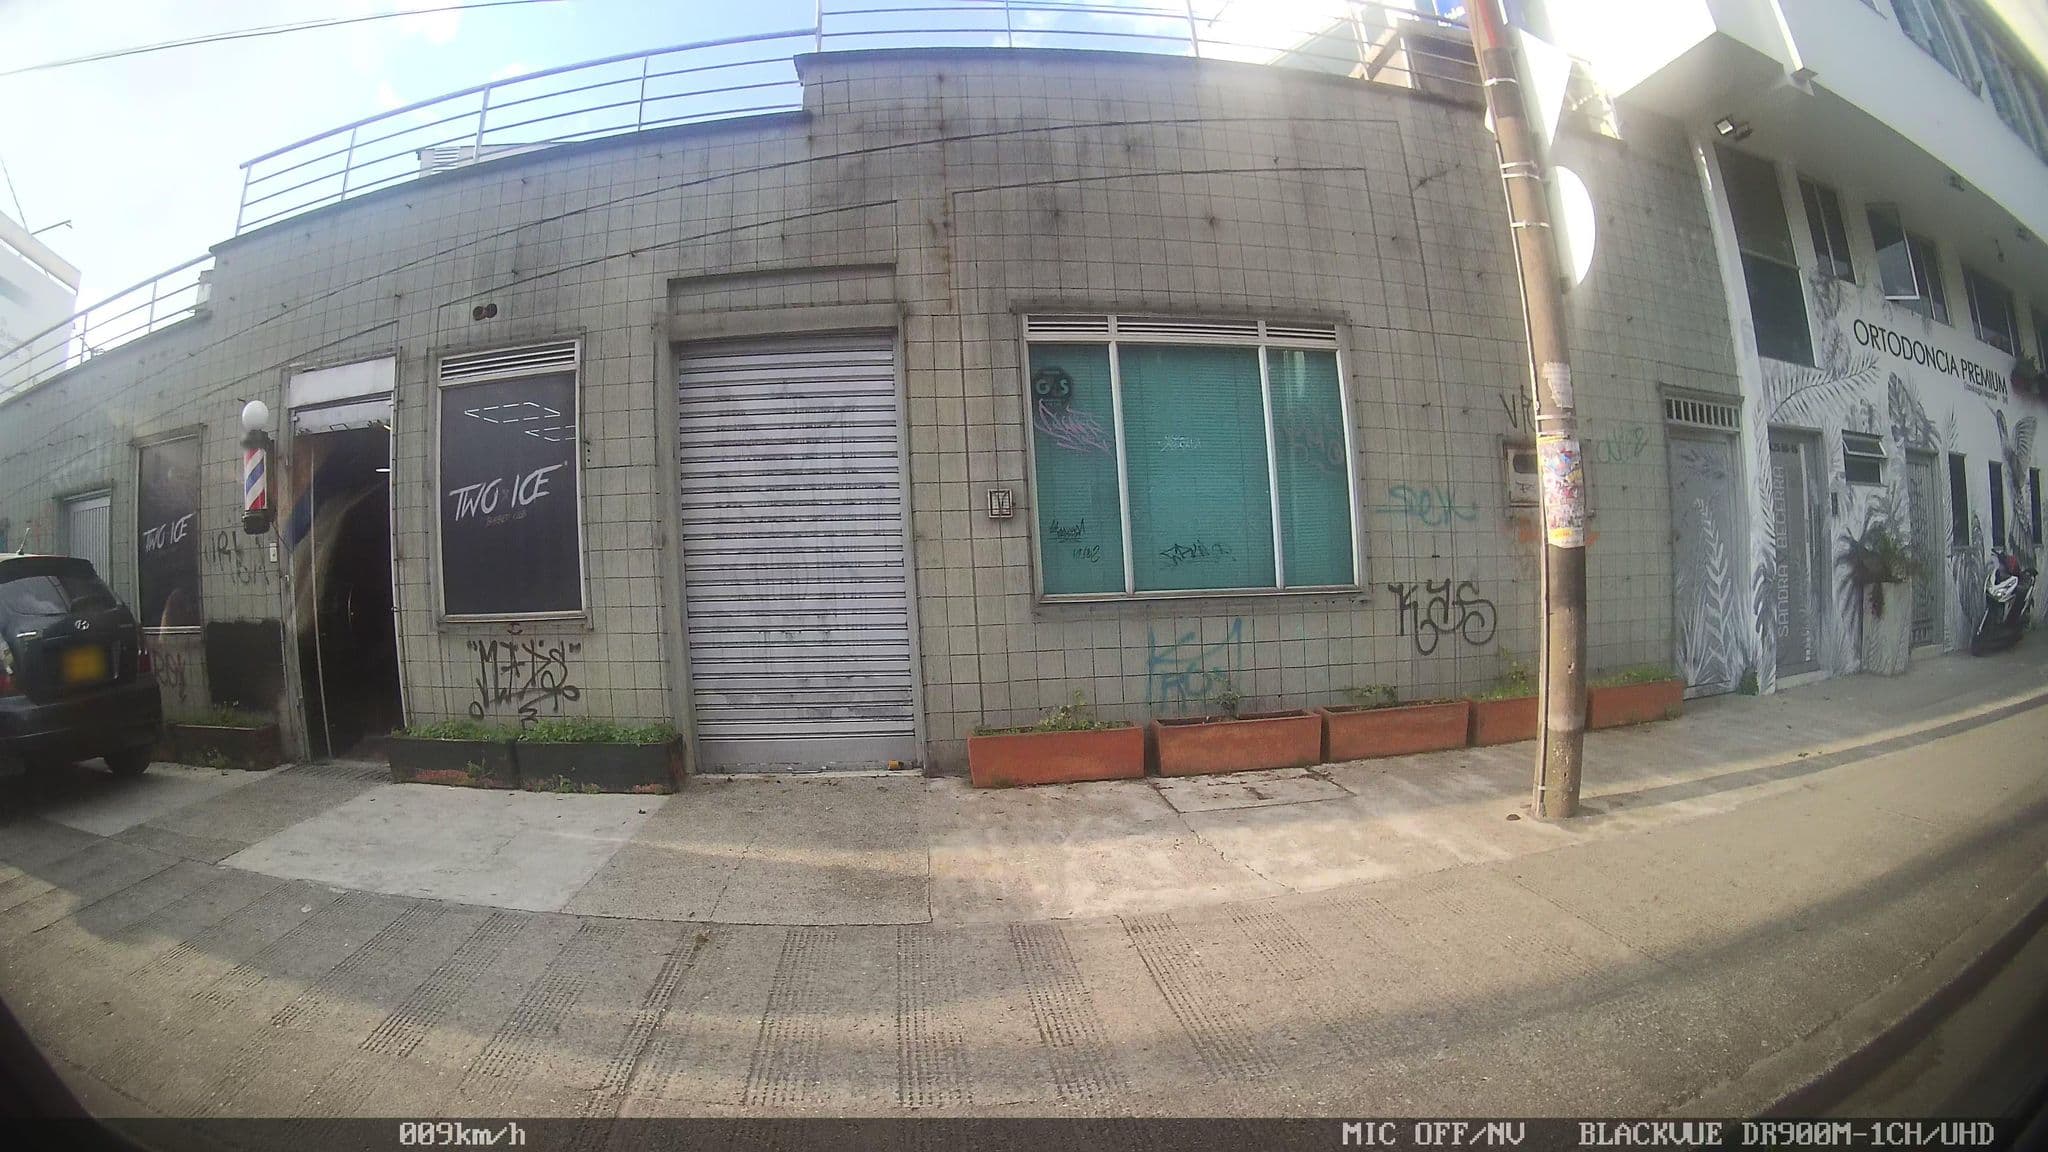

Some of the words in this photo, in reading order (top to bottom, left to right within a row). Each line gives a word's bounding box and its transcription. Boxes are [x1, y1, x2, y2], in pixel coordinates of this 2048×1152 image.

[1853, 319, 1960, 378] ORTODONCIA
[1960, 358, 2009, 395] PREMIUM
[448, 478, 502, 521] TWO
[511, 464, 563, 508] ICE
[143, 523, 167, 552] TWO
[170, 512, 196, 544] ICE
